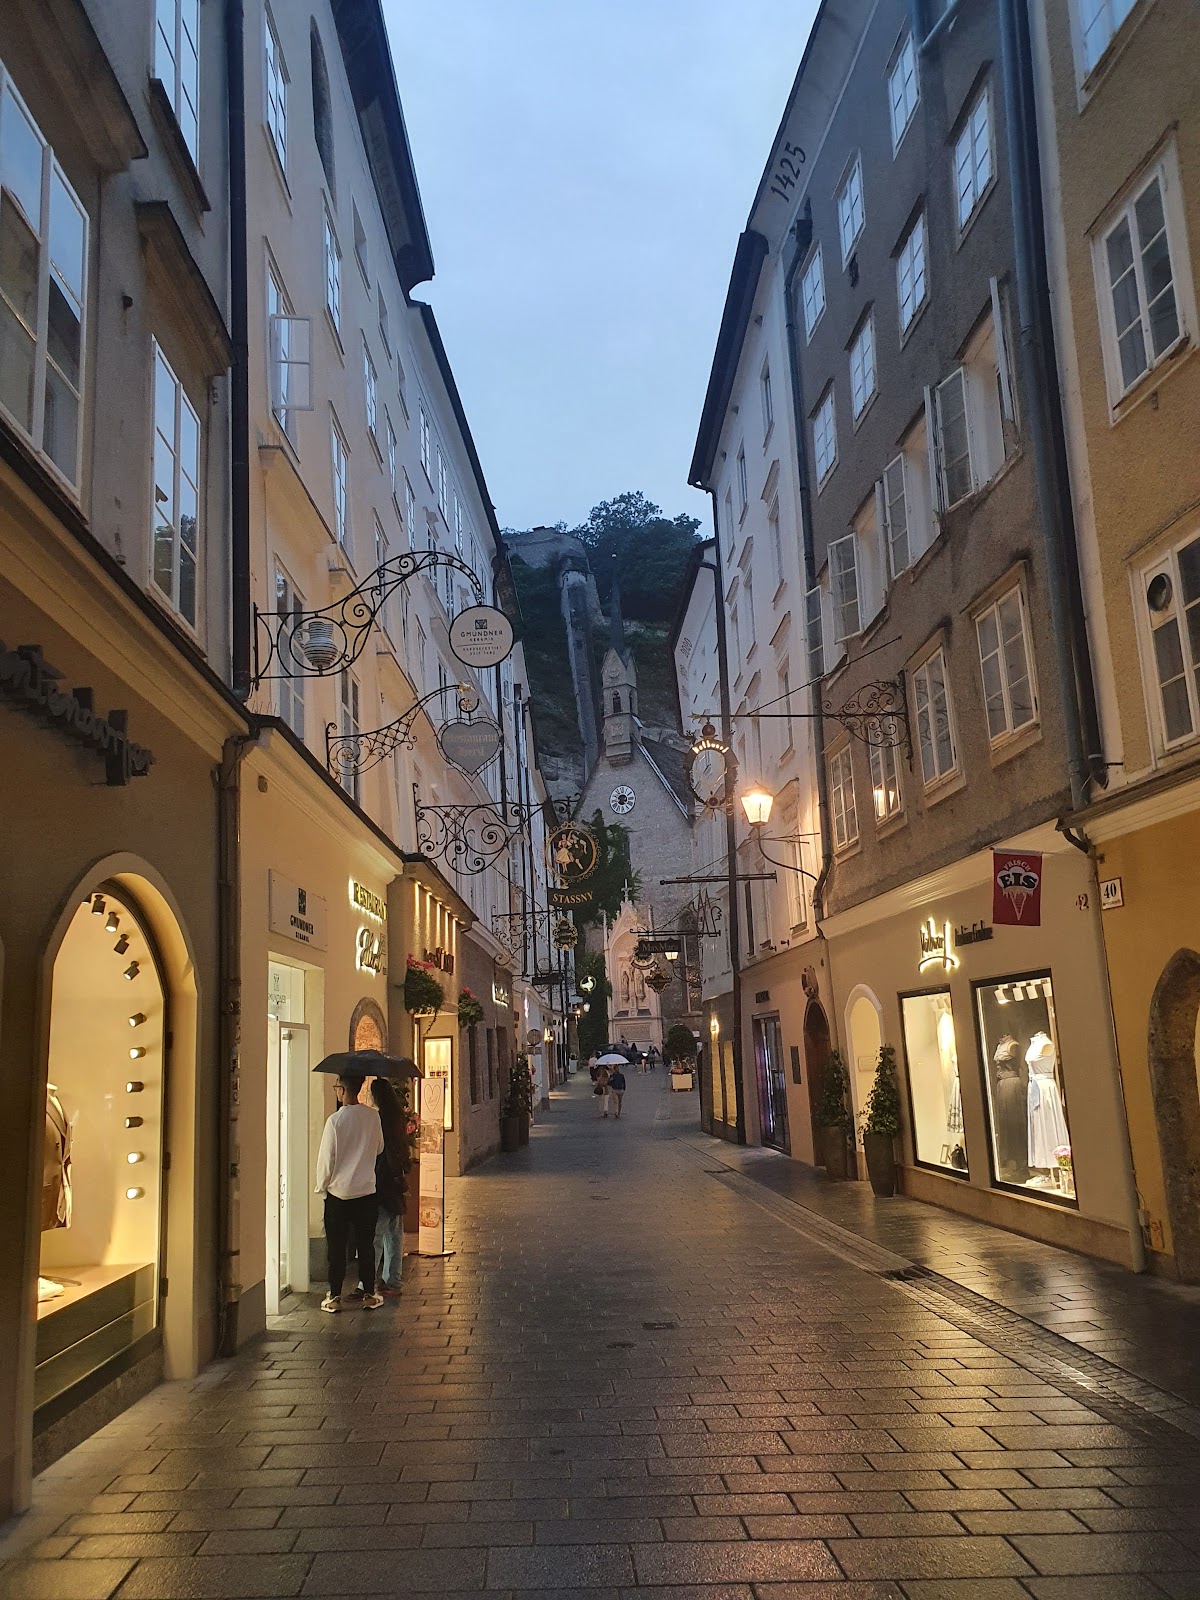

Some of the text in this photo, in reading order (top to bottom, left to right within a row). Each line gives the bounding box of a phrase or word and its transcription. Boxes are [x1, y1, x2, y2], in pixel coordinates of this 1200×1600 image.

[771, 142, 806, 203] 1425
[999, 872, 1038, 889] EIS
[552, 891, 594, 904] STASSNY
[1104, 882, 1117, 899] 40
